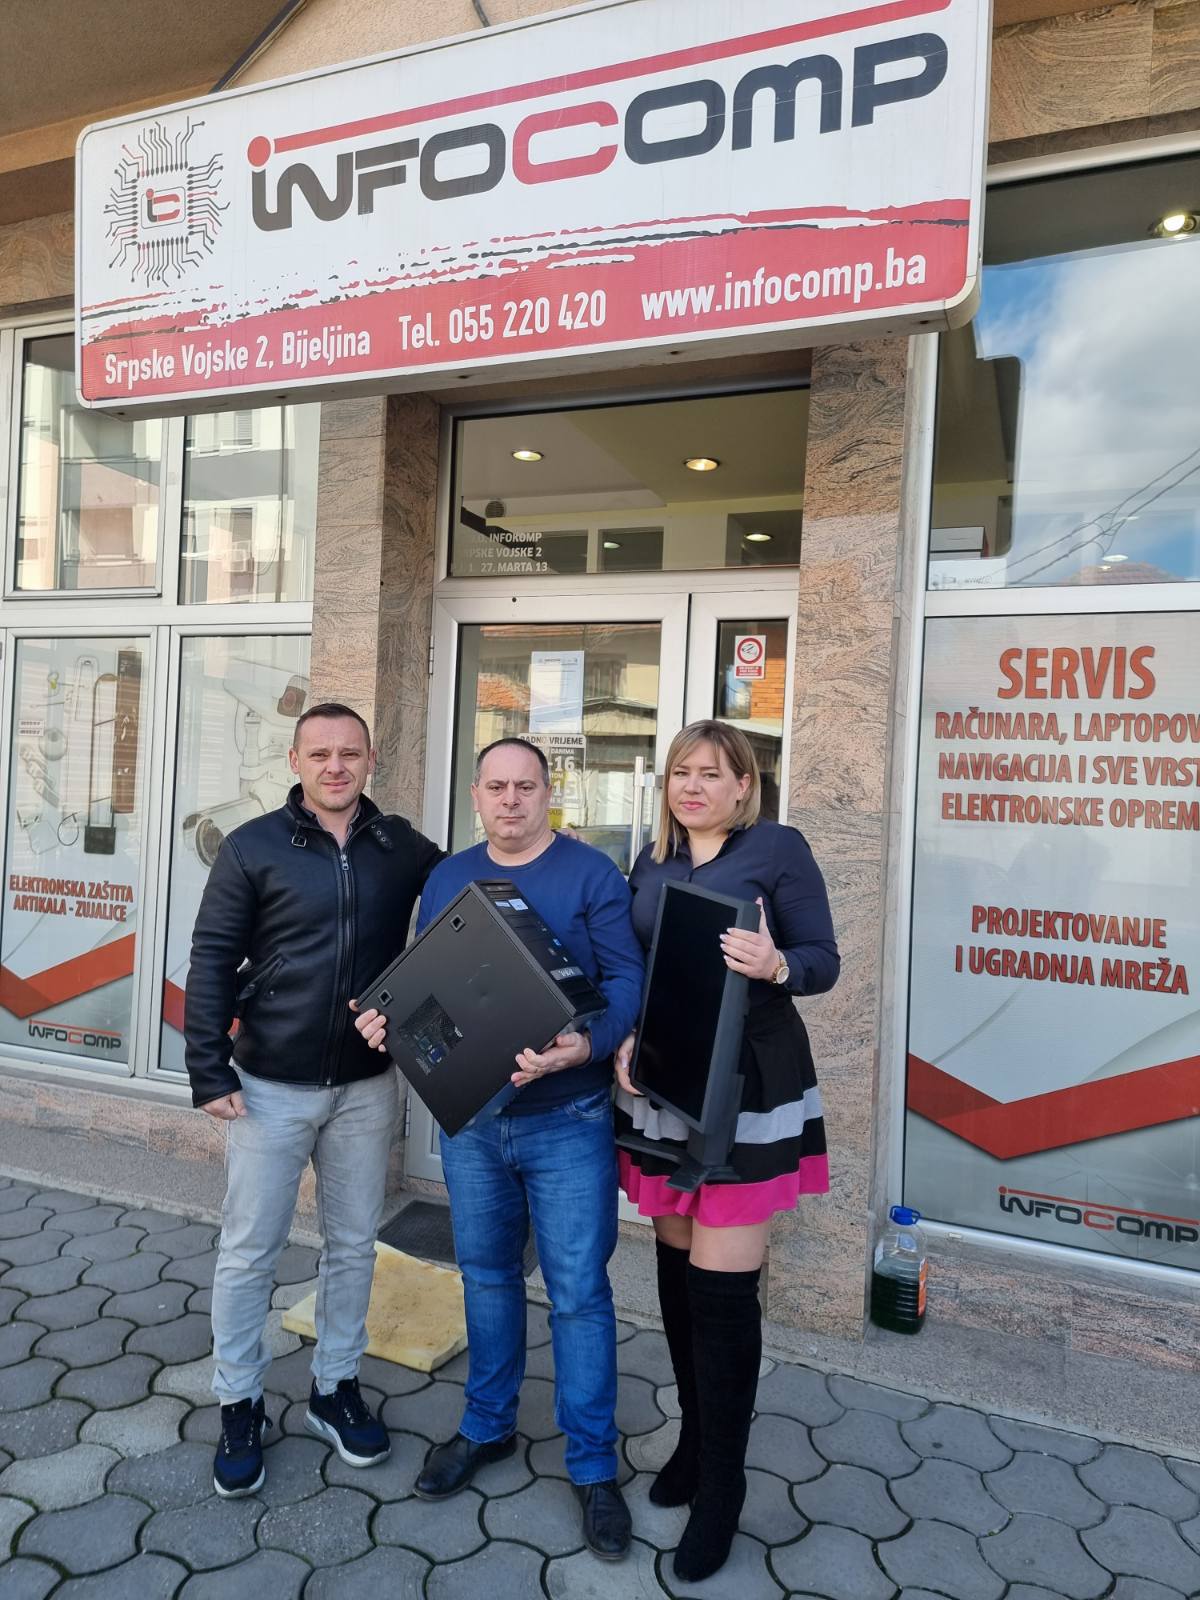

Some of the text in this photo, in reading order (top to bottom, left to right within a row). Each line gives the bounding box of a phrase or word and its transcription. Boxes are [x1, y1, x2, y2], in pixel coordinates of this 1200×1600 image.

[247, 32, 948, 232] INFOCOMP
[105, 246, 926, 390] Srpske Vojske 2, Bijeljina Tel. 055 220 420 www.infocomp.ba
[489, 532, 543, 543] INFOKOMP
[496, 547, 534, 558] VOJSKE
[535, 547, 542, 557] 2
[497, 562, 533, 572] MARTA
[535, 561, 548, 572] 13
[997, 645, 1157, 700] SERVIS
[549, 736, 584, 746] VRIJEME
[934, 706, 1068, 745] RAČUNARA,
[938, 752, 1073, 783] NAVIGACIJA
[1078, 755, 1086, 784] I
[1091, 756, 1138, 785] SVE
[941, 792, 1105, 827] ELEKTRONSKE
[9, 874, 134, 903] ELEKTRONSKA ZAŠTITA
[13, 894, 67, 916] ARTIKALA
[75, 900, 127, 922] ZUJALICE
[971, 905, 1167, 949] PROJEKTOVANJE
[955, 945, 1190, 995] I UGRADNJA MREŽA
